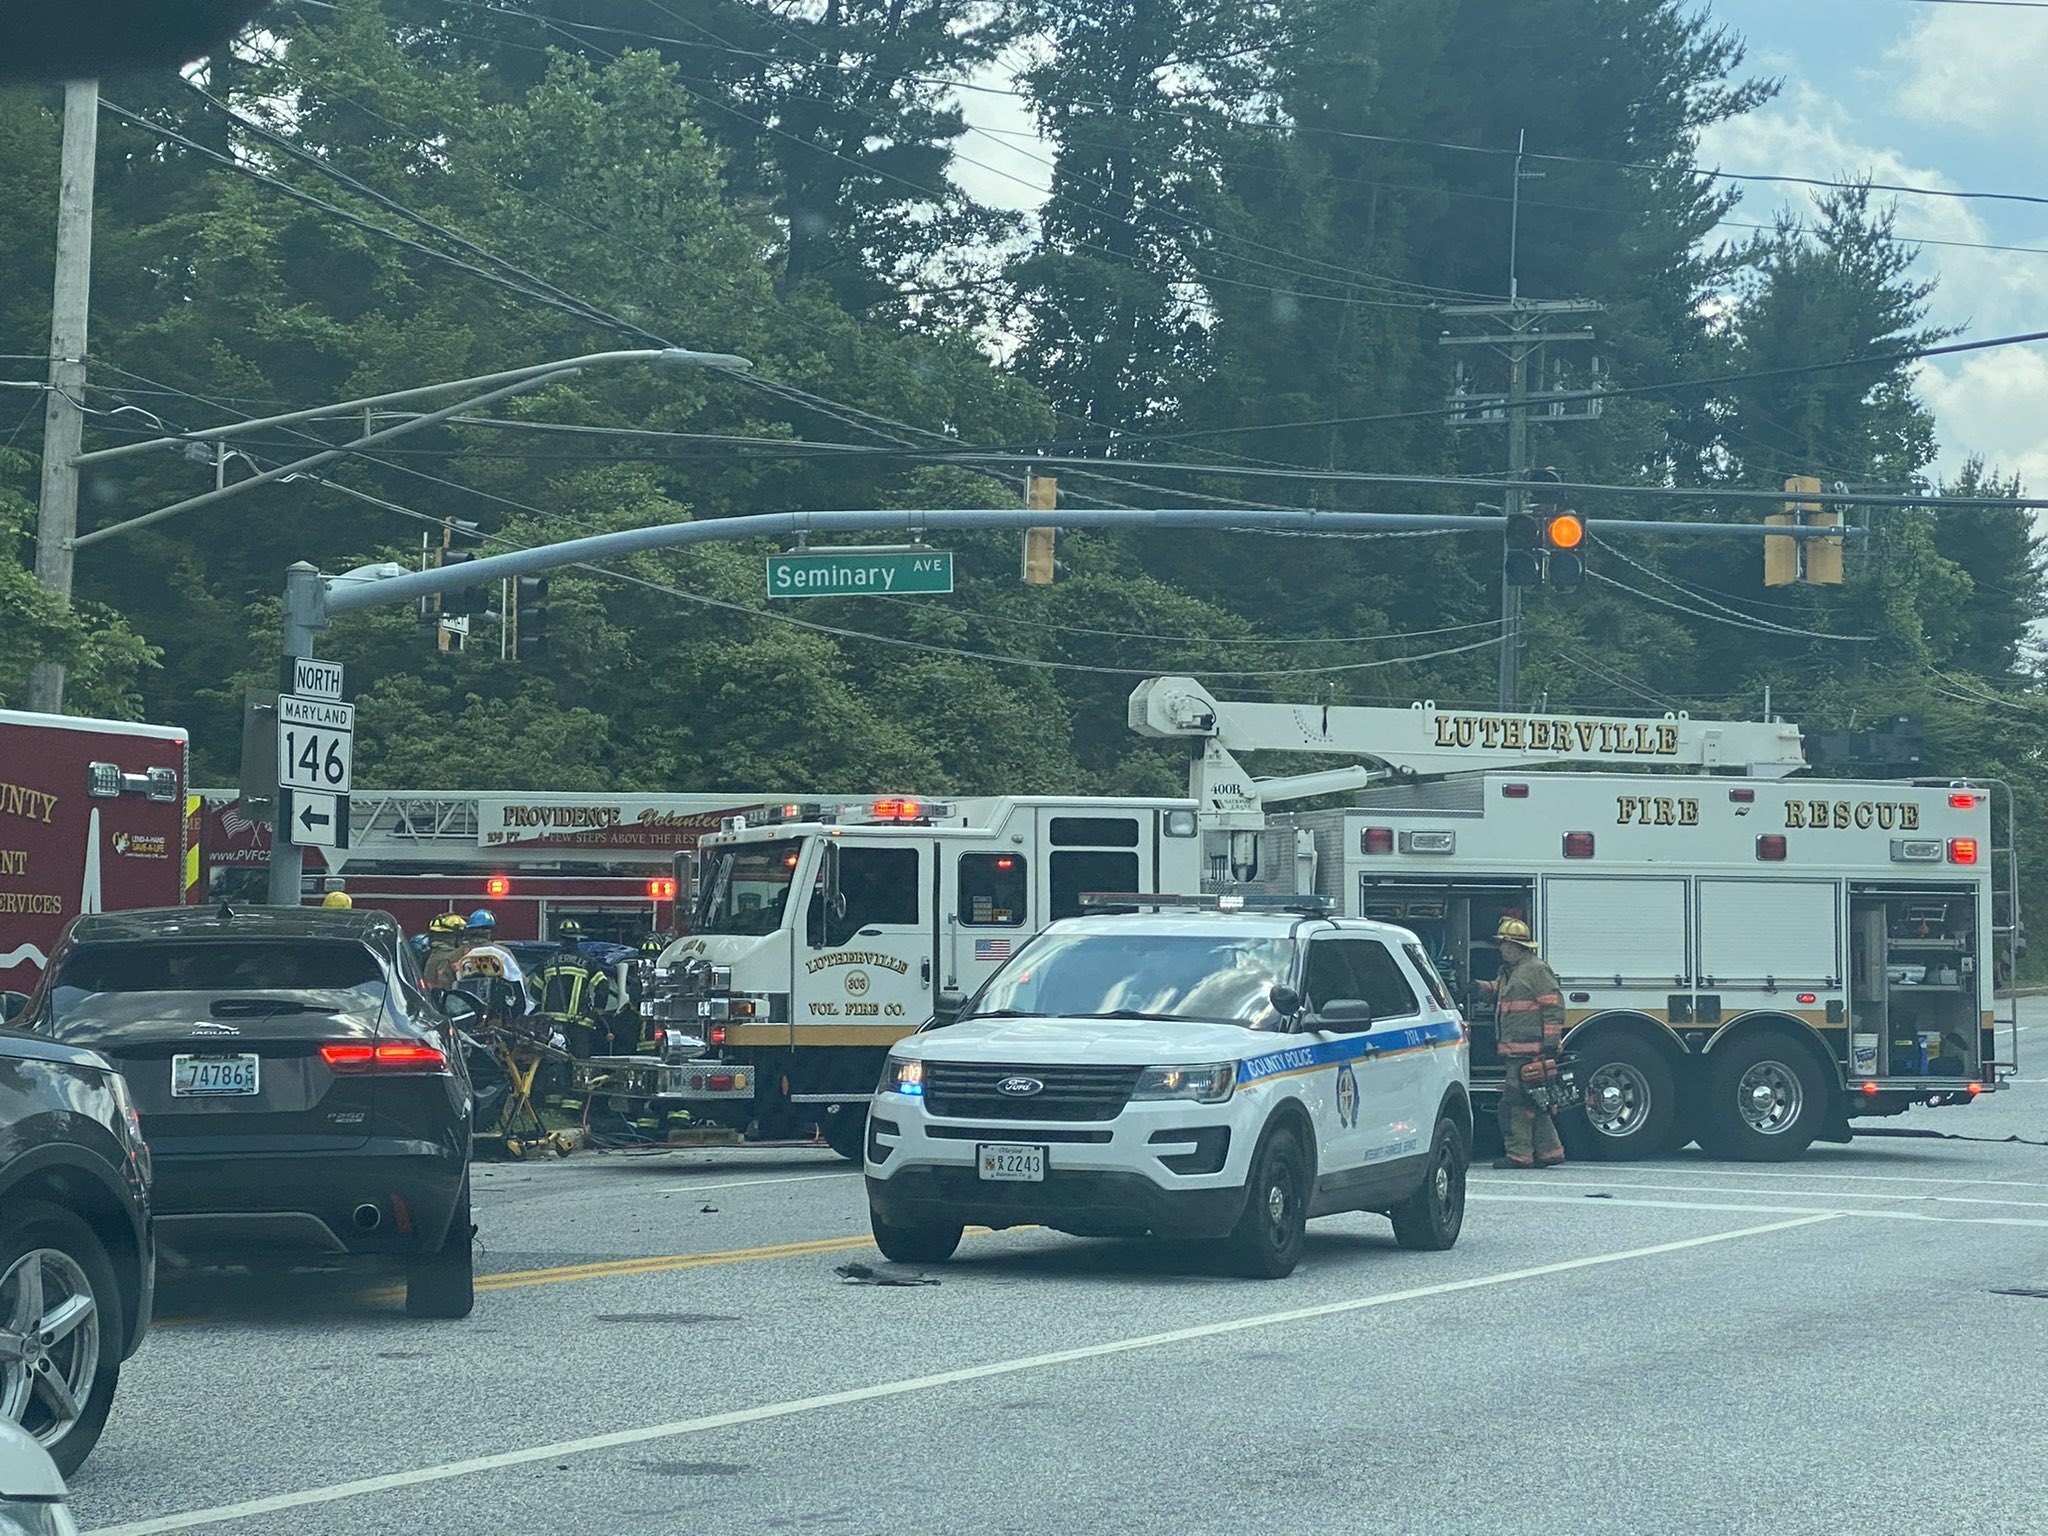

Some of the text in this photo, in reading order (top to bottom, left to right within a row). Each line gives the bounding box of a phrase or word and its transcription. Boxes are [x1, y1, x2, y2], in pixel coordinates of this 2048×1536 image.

[776, 559, 942, 590] Seminary AVE
[297, 666, 340, 693] NORTH
[285, 702, 347, 724] MARYLAND
[1434, 715, 1679, 755] LUTHERVILLE
[286, 731, 344, 784] 146
[1210, 783, 1240, 795] 400B
[503, 805, 621, 828] PROVIDENCE
[1617, 796, 1700, 826] FIRE
[1785, 800, 1920, 829] RESCUE
[549, 832, 572, 843] FEW
[576, 832, 607, 844] STEPS
[610, 833, 646, 844] ABOVE
[649, 833, 671, 845] THE
[805, 951, 909, 975] LUTHERVILLE
[844, 1003, 879, 1017] FIRE
[883, 1002, 906, 1017] CO.
[1247, 1048, 1315, 1077] COUNTY POLICE
[188, 1065, 243, 1087] 74786
[1004, 1079, 1032, 1091] Ford
[1007, 1155, 1040, 1173] 2243
